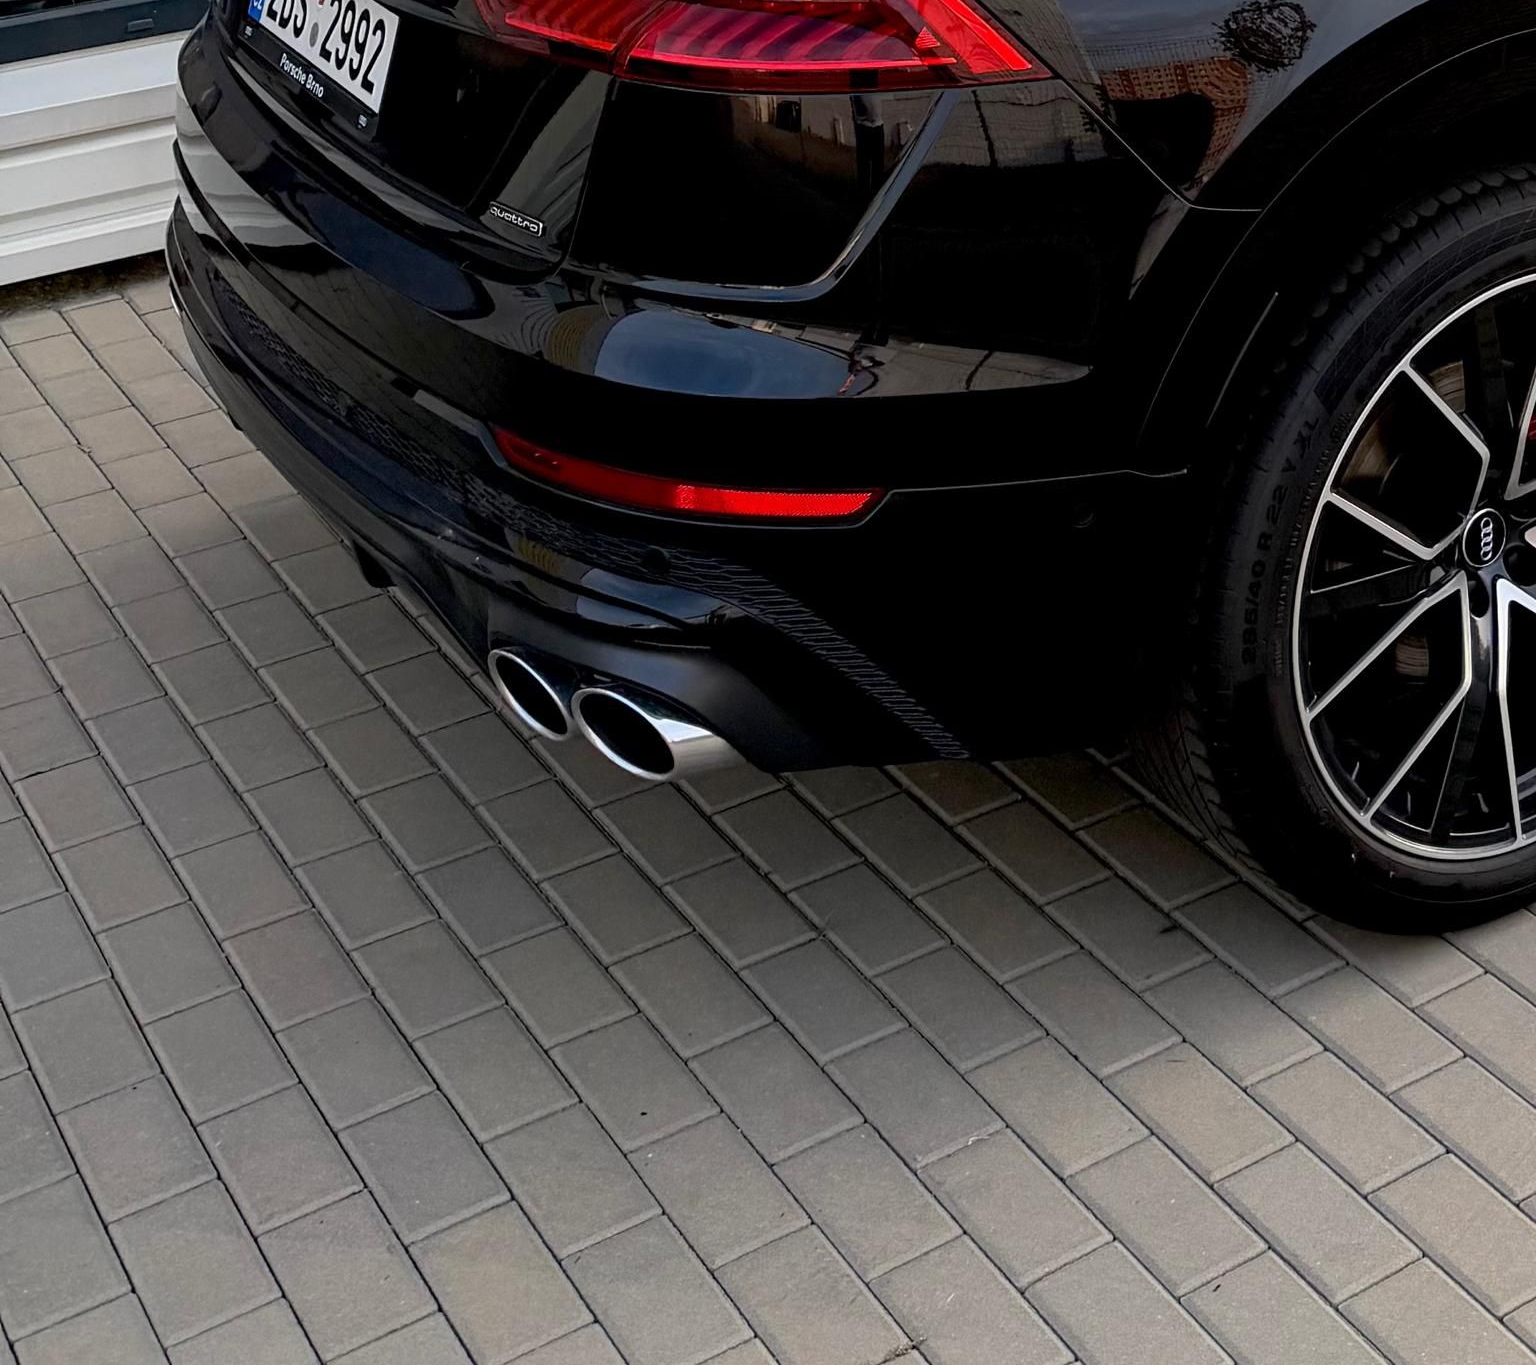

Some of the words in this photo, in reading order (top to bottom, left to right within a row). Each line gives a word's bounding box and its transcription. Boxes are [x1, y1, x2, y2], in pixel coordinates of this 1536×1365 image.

[279, 53, 307, 85] Porsche
[305, 71, 325, 98] Brno
[490, 206, 539, 232] quattro
[1256, 531, 1273, 551] R
[1266, 484, 1288, 525] 22
[1293, 416, 1320, 460] XL
